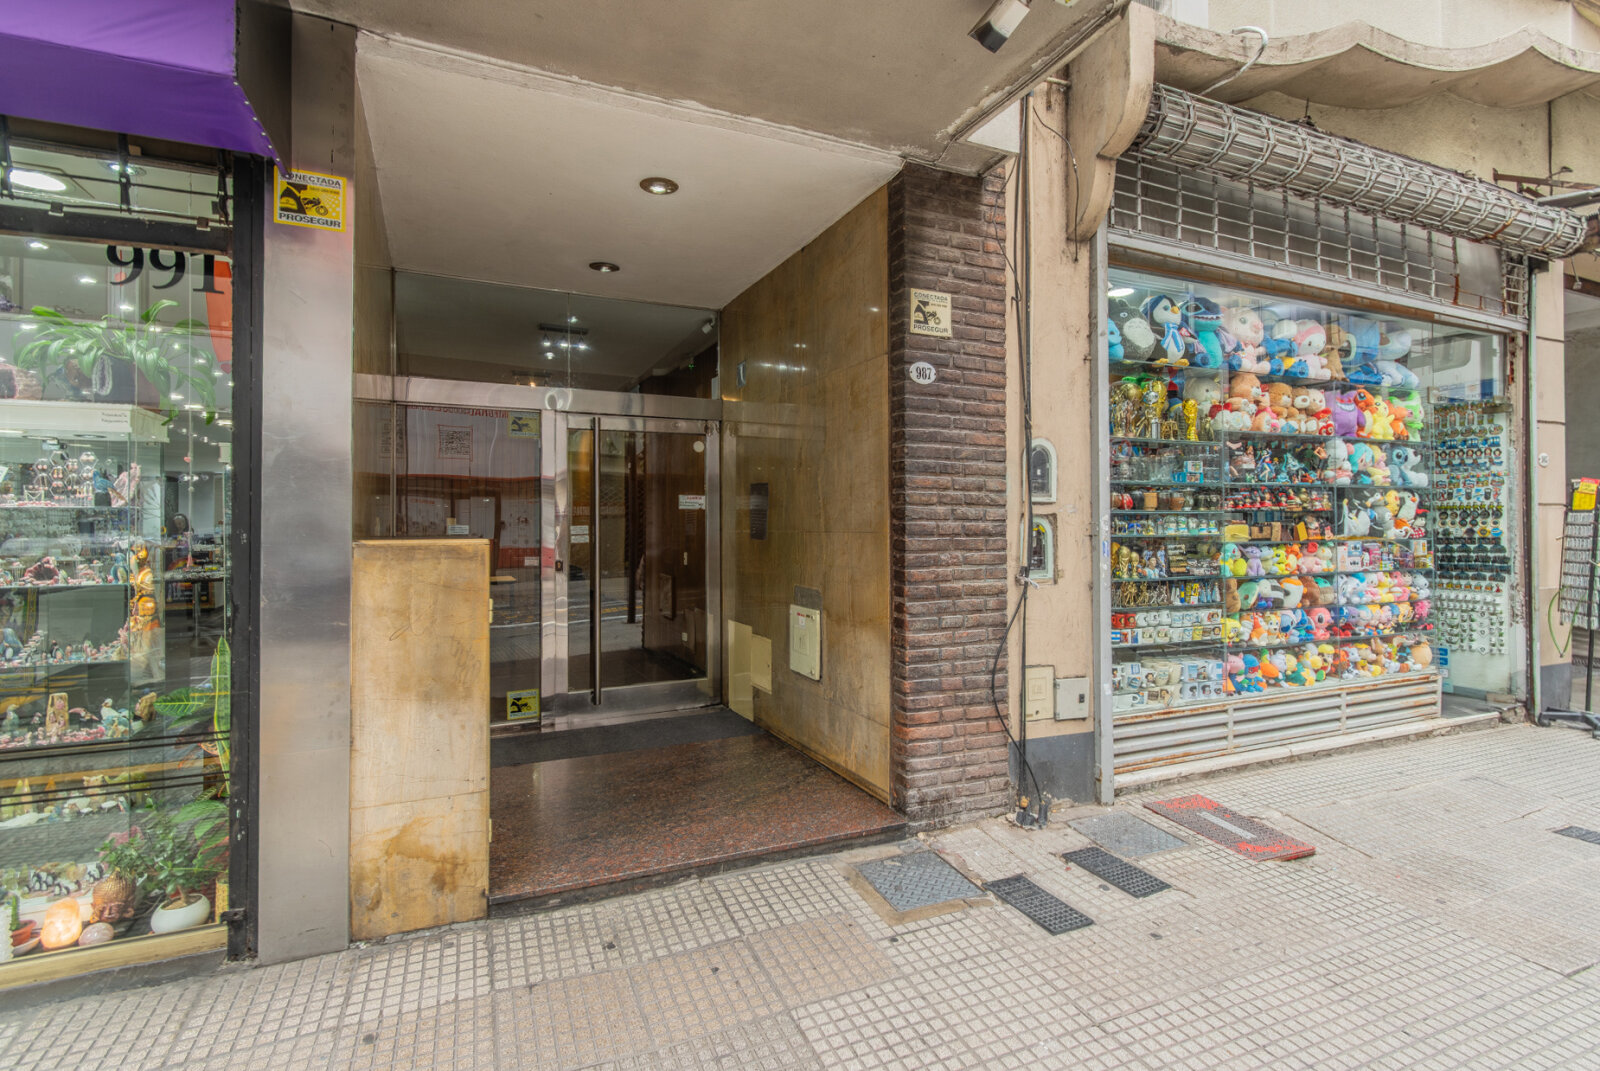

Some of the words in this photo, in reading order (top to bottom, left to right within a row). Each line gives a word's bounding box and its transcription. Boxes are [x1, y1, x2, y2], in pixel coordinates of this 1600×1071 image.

[279, 213, 341, 228] PROSEGUR
[106, 245, 225, 295] 991
[914, 292, 948, 301] CONECTADA
[914, 324, 948, 333] PROSEGUR
[915, 366, 932, 380] 987
